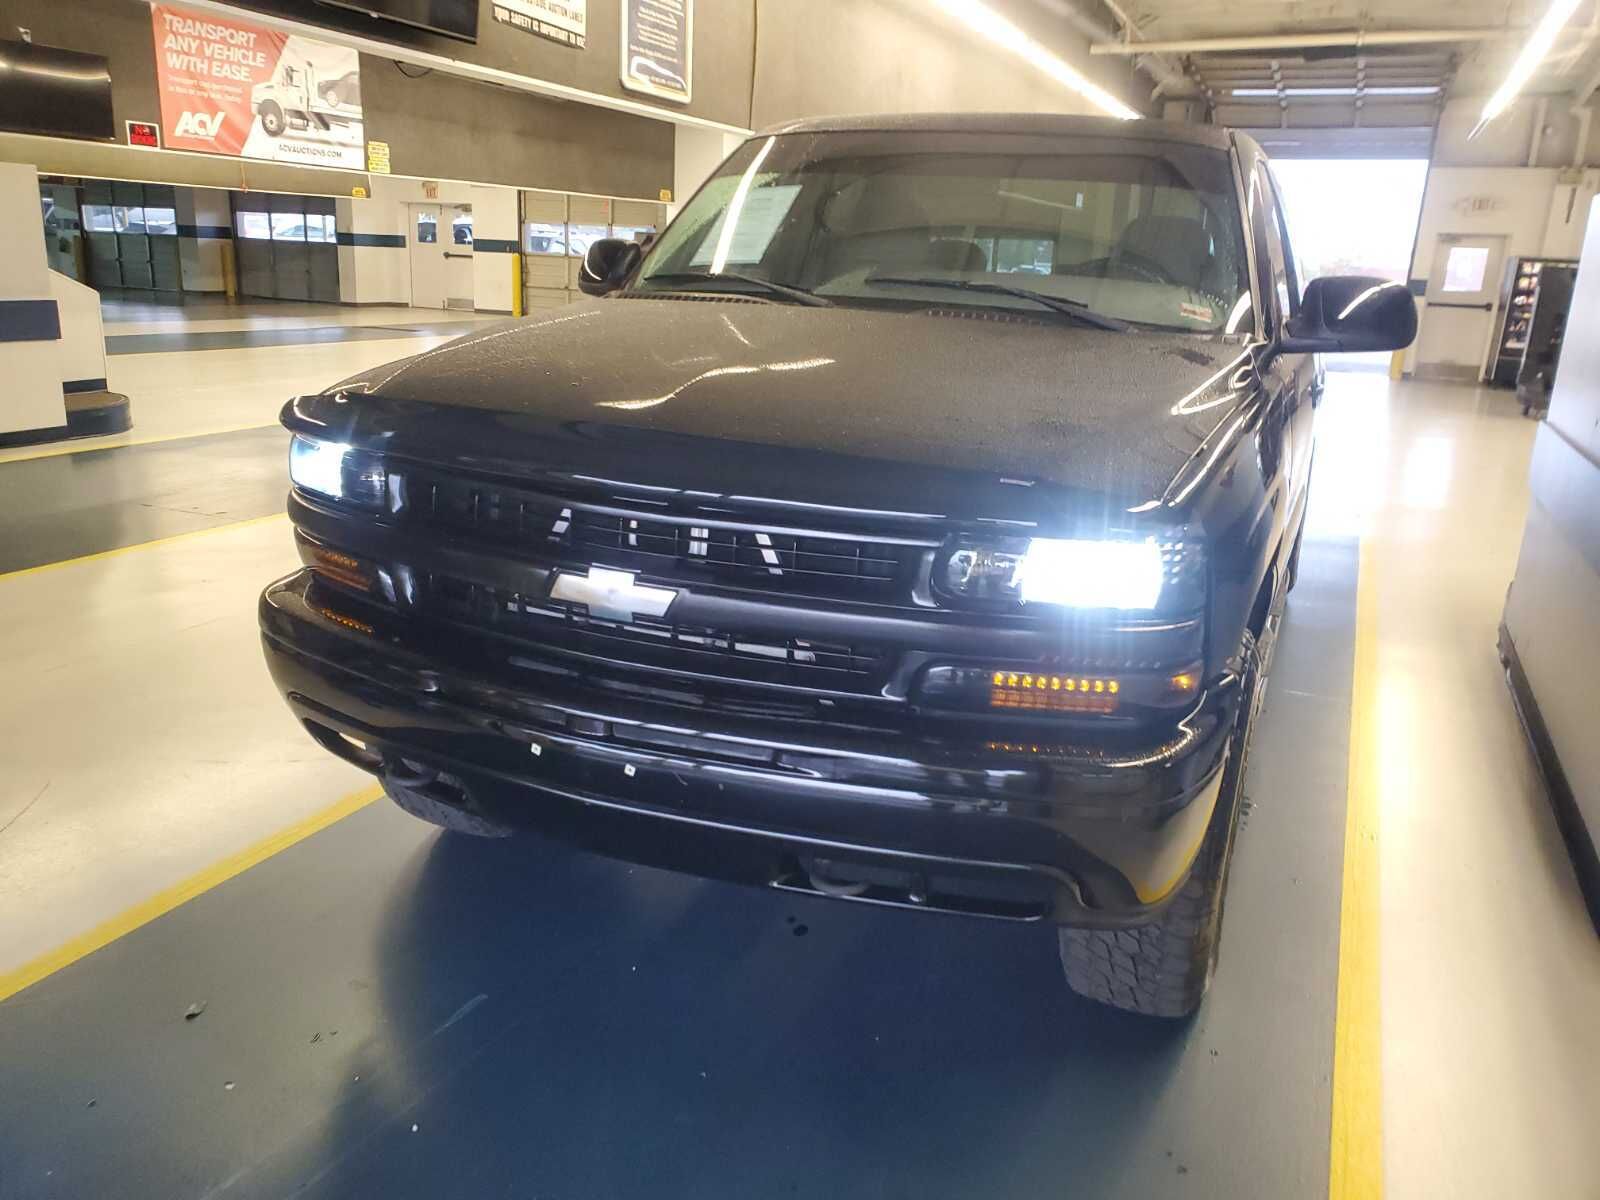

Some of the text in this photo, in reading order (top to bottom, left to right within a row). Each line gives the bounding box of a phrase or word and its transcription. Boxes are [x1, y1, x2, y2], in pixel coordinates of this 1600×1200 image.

[163, 13, 257, 48] TRANSPORT
[164, 33, 266, 67] ANY VEHICLE
[166, 52, 253, 82] WITH EASE.
[175, 111, 226, 136] ACV
